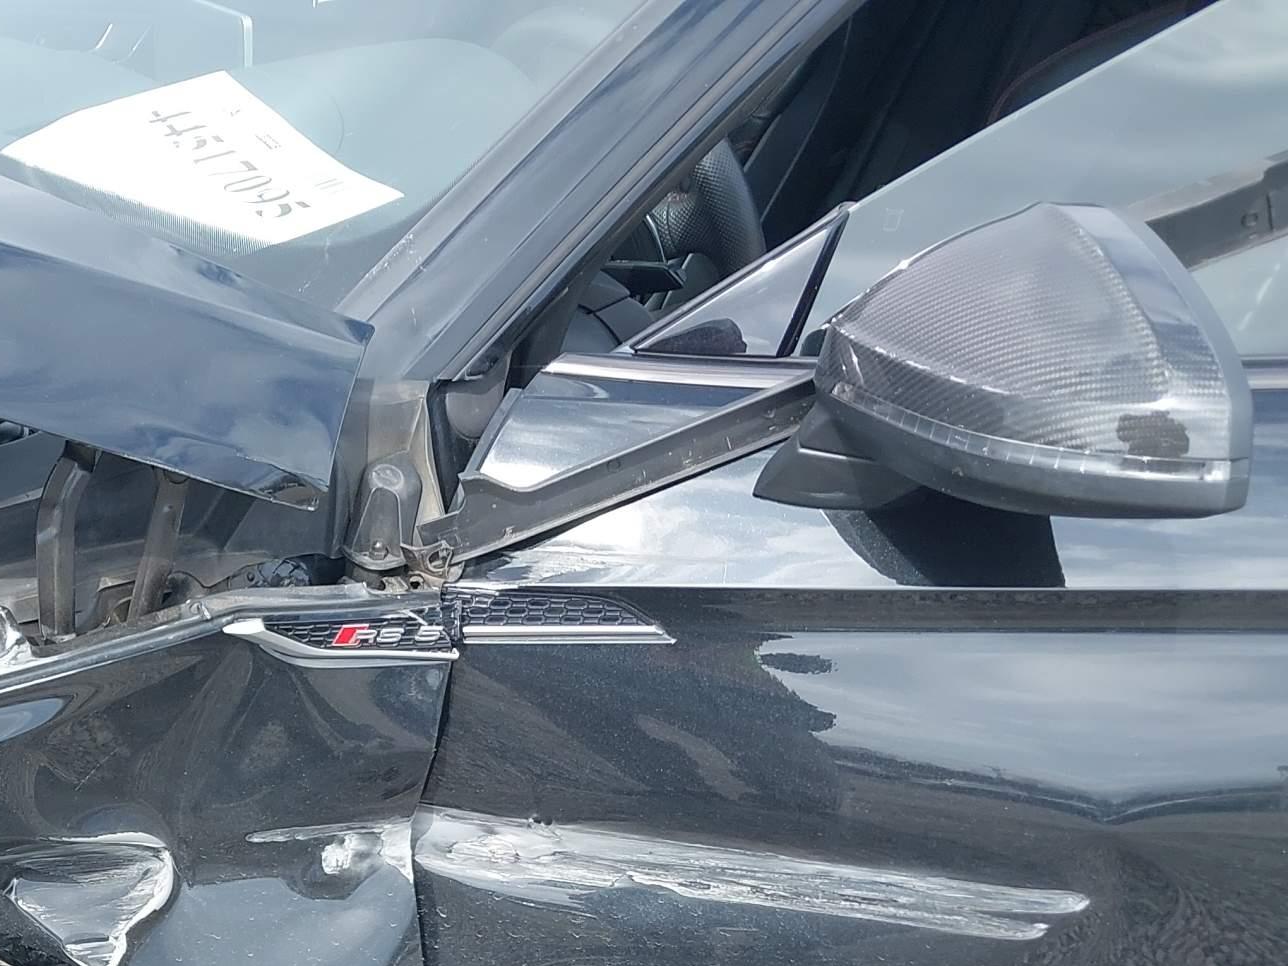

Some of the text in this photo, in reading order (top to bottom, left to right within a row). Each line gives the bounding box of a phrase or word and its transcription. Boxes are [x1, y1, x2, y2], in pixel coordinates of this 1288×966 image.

[148, 109, 312, 219] 44517095
[332, 624, 444, 647] RS 5
